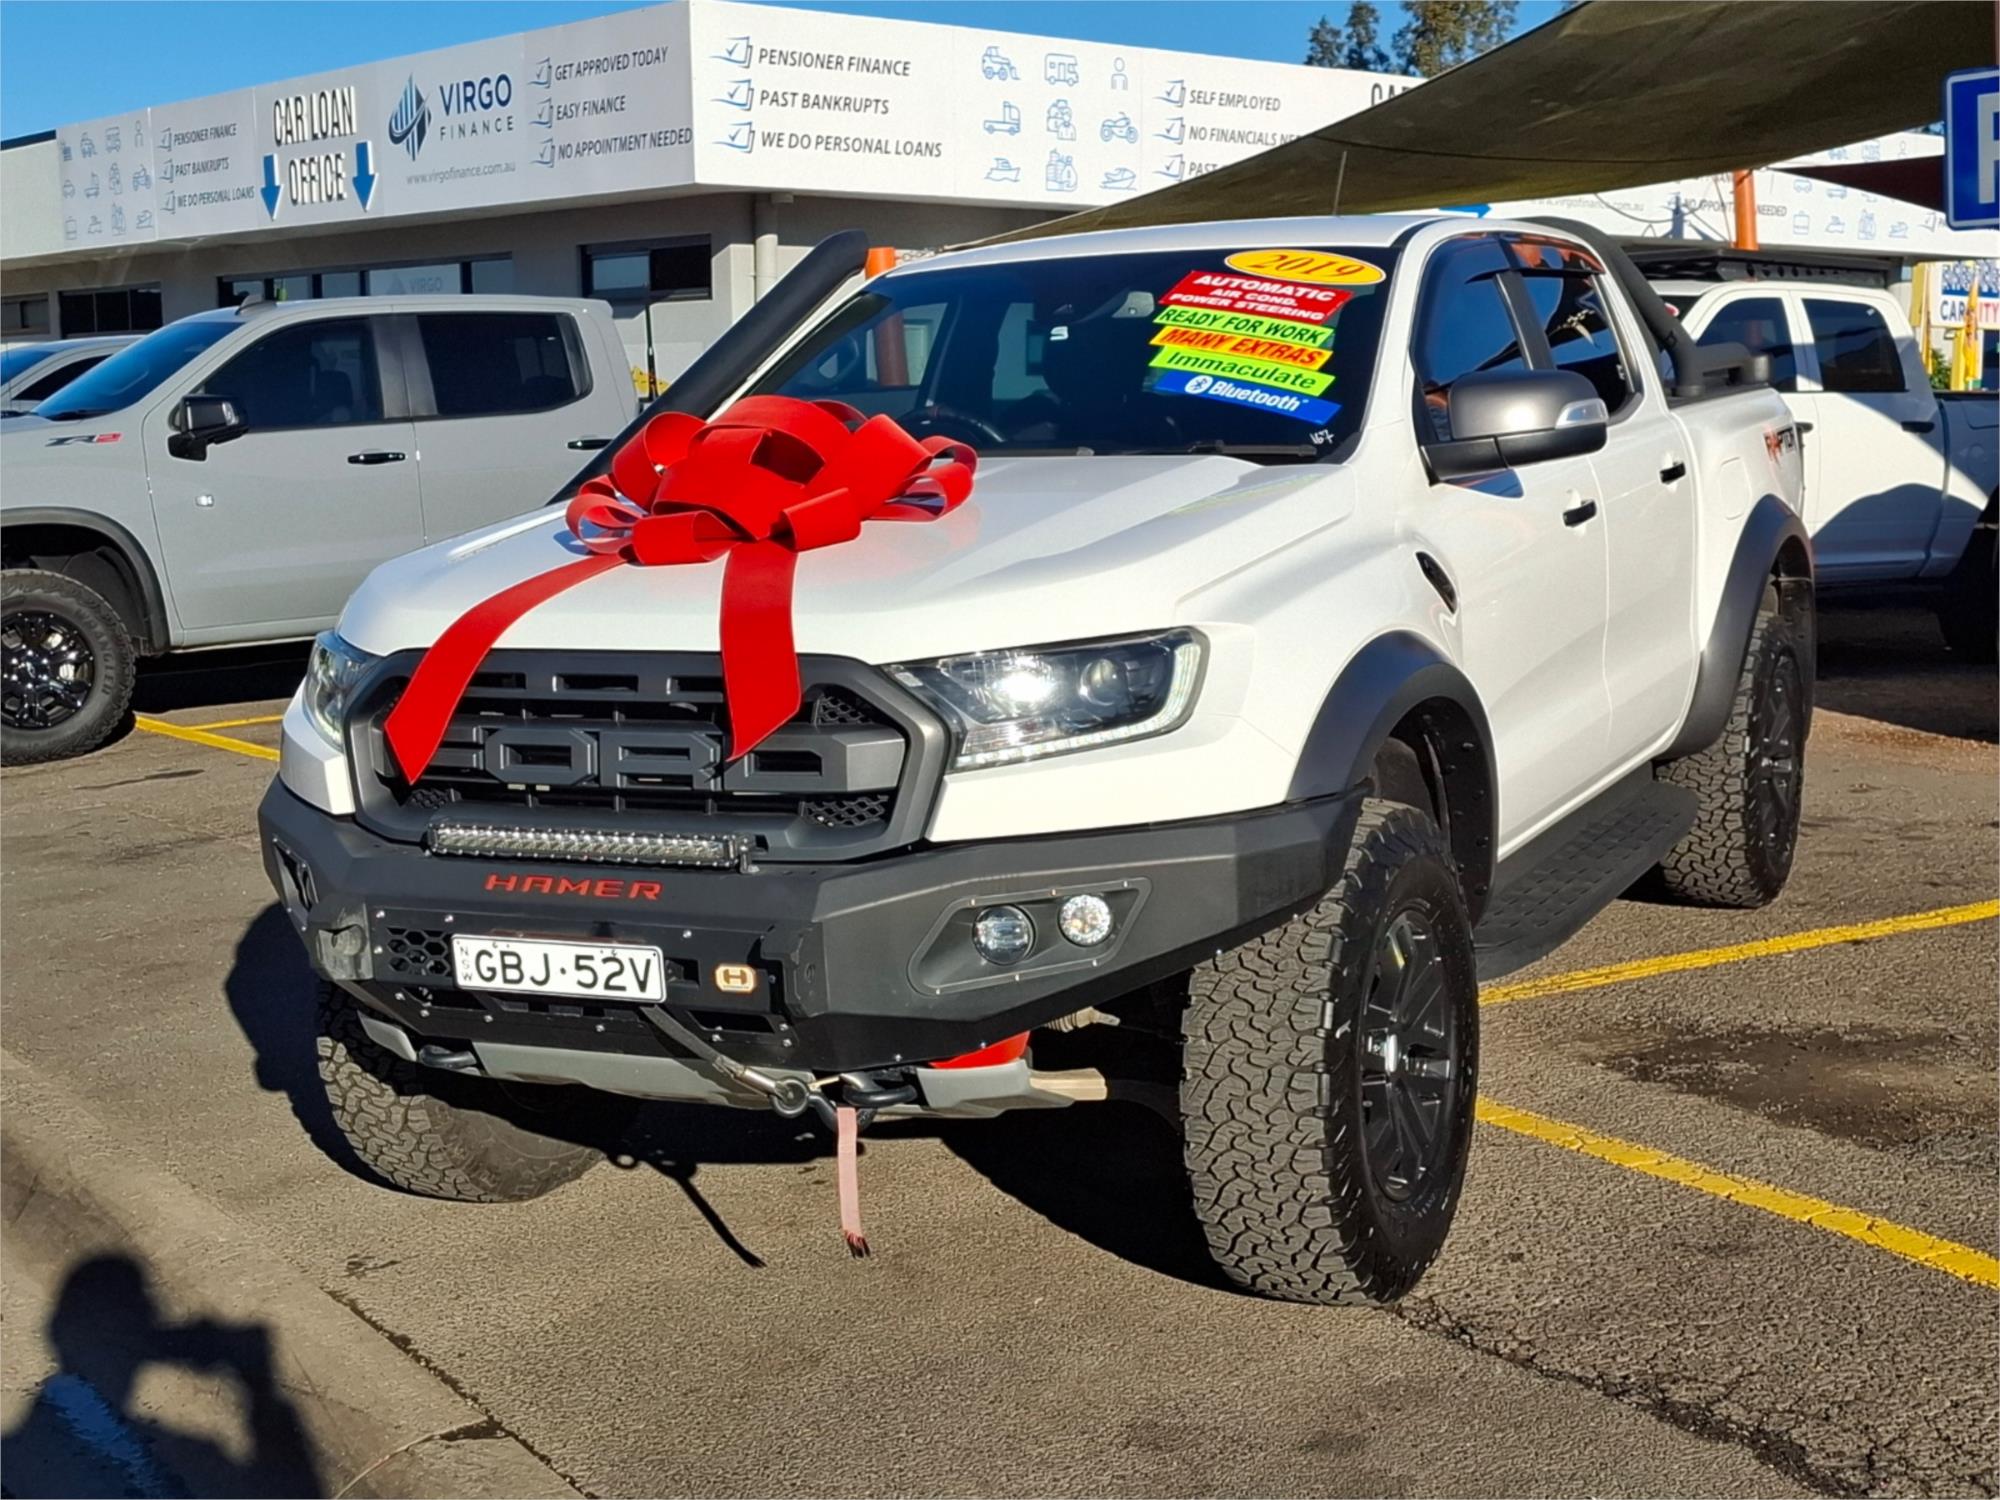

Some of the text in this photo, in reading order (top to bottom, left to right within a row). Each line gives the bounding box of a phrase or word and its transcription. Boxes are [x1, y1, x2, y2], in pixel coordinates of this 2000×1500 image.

[555, 46, 668, 81] GET APPROVED TODAY
[758, 48, 911, 77] PENSIONER FINANCE
[440, 73, 512, 116] VIRGO
[557, 95, 626, 121] EASY FINANCE
[760, 89, 889, 115] PAST BANKRUPTS
[1189, 89, 1281, 112] SELF EMPLOYED
[273, 86, 357, 147] CAR LOAN
[440, 116, 514, 141] FINANCE
[174, 122, 237, 146] PENSIONER FINANCE
[558, 127, 693, 160] NO APPOINTMENT NEEDED
[761, 131, 942, 158] WE DO PERSONAL LOANS
[1189, 125, 1207, 141] NO
[1209, 127, 1277, 146] FINANCIALS
[175, 156, 229, 177] PAST BANKRUPTS
[287, 152, 347, 206] OFFICE
[406, 161, 515, 186] www.virgofinance.com.au
[177, 185, 255, 208] WE DO PERSONAL LOANS
[1250, 253, 1367, 279] 2019
[1193, 274, 1336, 301] AUTOMATIC
[1210, 288, 1298, 307] AIR COND.
[1169, 292, 1325, 321] POWER STEERING
[1159, 308, 1326, 345] READY FOR WORK
[1161, 327, 1323, 366] MANY EXTRAS
[1167, 351, 1317, 390] Immaculate
[1209, 379, 1301, 412] Bluetooth
[45, 432, 122, 447] ZR2
[484, 872, 663, 900] HAMER
